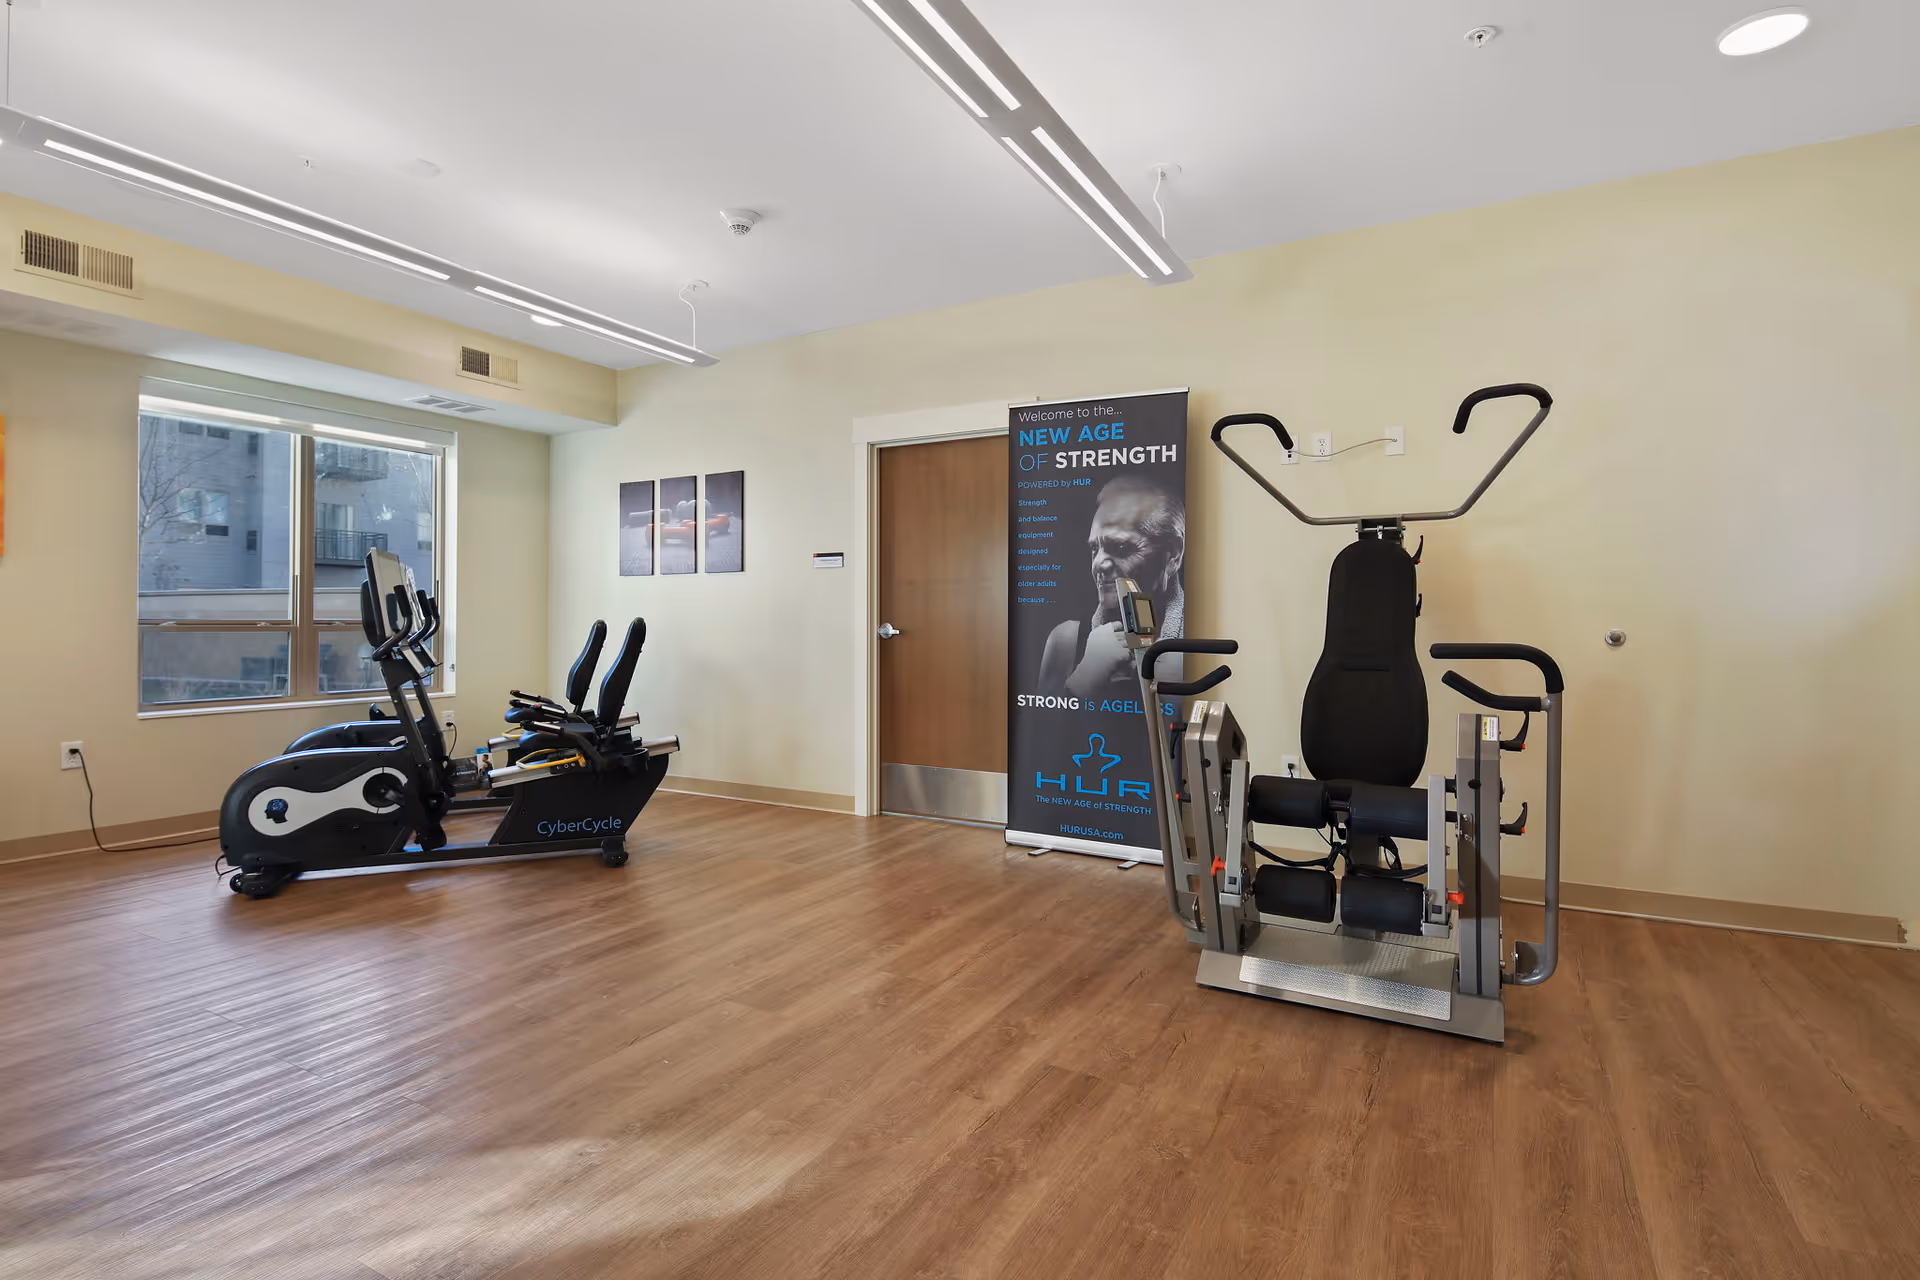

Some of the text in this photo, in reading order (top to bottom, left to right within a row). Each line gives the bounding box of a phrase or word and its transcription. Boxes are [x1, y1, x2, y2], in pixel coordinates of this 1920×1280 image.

[1019, 405, 1122, 422] Welcome to the...
[1020, 422, 1124, 446] NEW AGE
[1020, 445, 1177, 471] OF STRENGTH
[1018, 478, 1091, 488] POWERED by HUR
[1018, 499, 1047, 507] Strength
[1017, 694, 1080, 710] STRONG
[1100, 699, 1174, 716] AGELS
[1036, 771, 1150, 800] HUR
[1036, 795, 1050, 803] The
[1052, 797, 1072, 806] NEW
[1074, 800, 1091, 808] AGE
[1105, 803, 1152, 815] STRENGTH
[537, 815, 622, 837] CyberCycle
[1060, 824, 1124, 840] HURUSA.com
